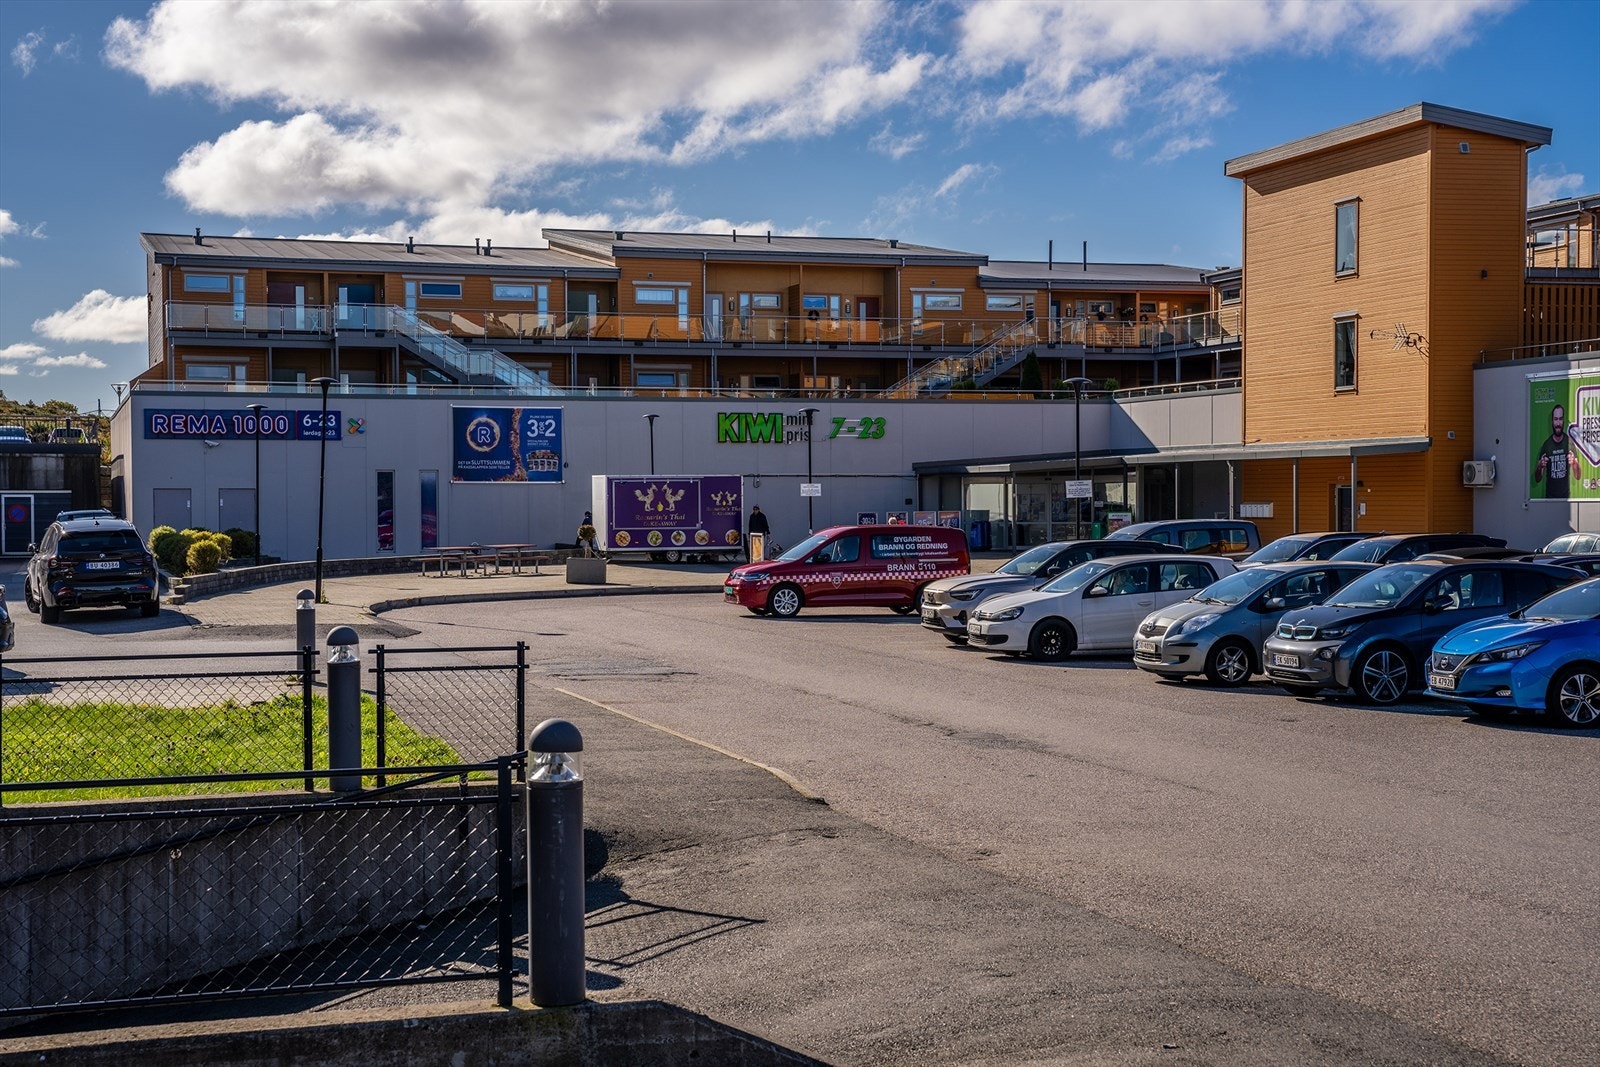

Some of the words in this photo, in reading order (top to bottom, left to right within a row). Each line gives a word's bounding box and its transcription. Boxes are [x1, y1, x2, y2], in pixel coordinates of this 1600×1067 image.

[152, 414, 227, 434] REMA
[233, 415, 289, 434] 1000
[527, 419, 539, 437] 3
[544, 419, 556, 437] 2
[717, 412, 784, 443] KIWI
[829, 417, 886, 439] 7-23
[303, 429, 321, 437] lørdag
[477, 426, 491, 443] R
[786, 428, 810, 444] pris
[879, 543, 904, 551] BRANN
[924, 563, 936, 571] 110
[1276, 656, 1283, 664] EK
[1431, 676, 1438, 685] EB
